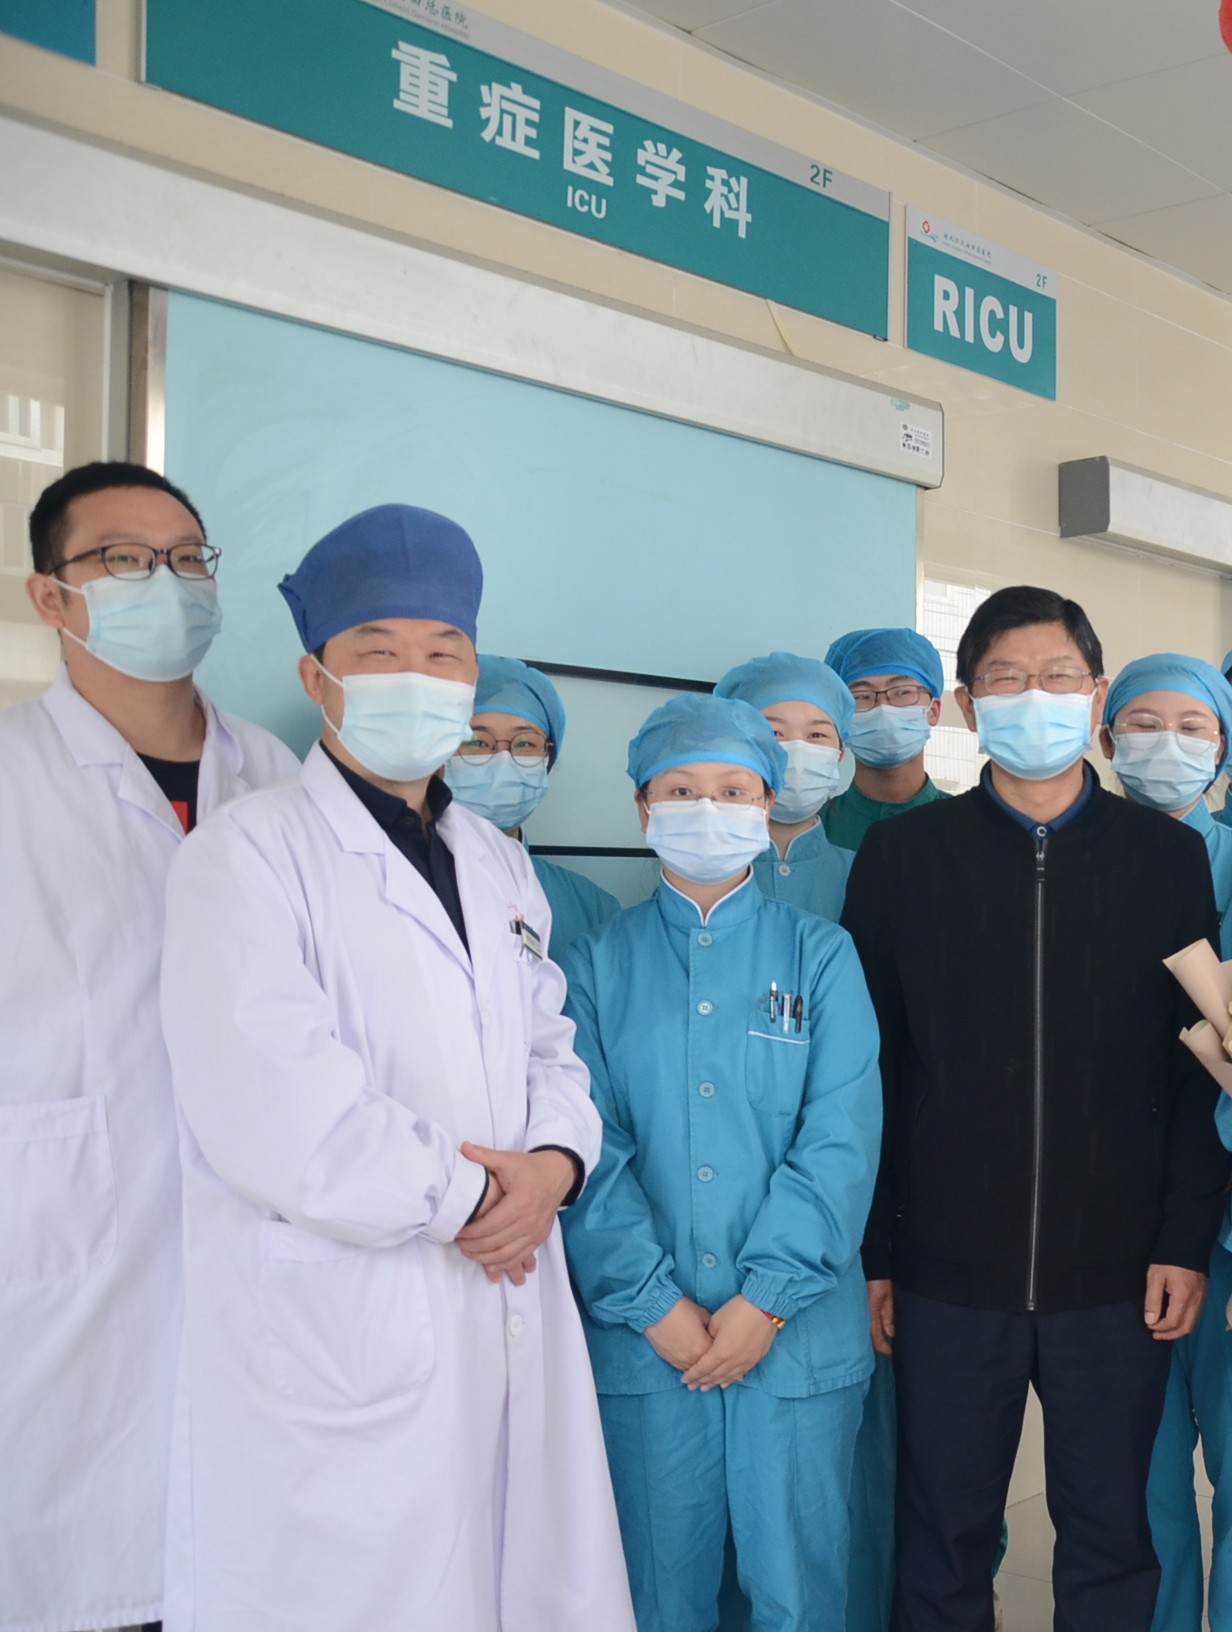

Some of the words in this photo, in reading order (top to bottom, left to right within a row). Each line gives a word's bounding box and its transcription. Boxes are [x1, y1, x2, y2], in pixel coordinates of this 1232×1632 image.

[391, 40, 753, 239] 重症医学科
[810, 164, 833, 188] 2F
[566, 184, 607, 219] ICU
[1036, 273, 1048, 288] 2F
[933, 273, 1034, 363] RICU
